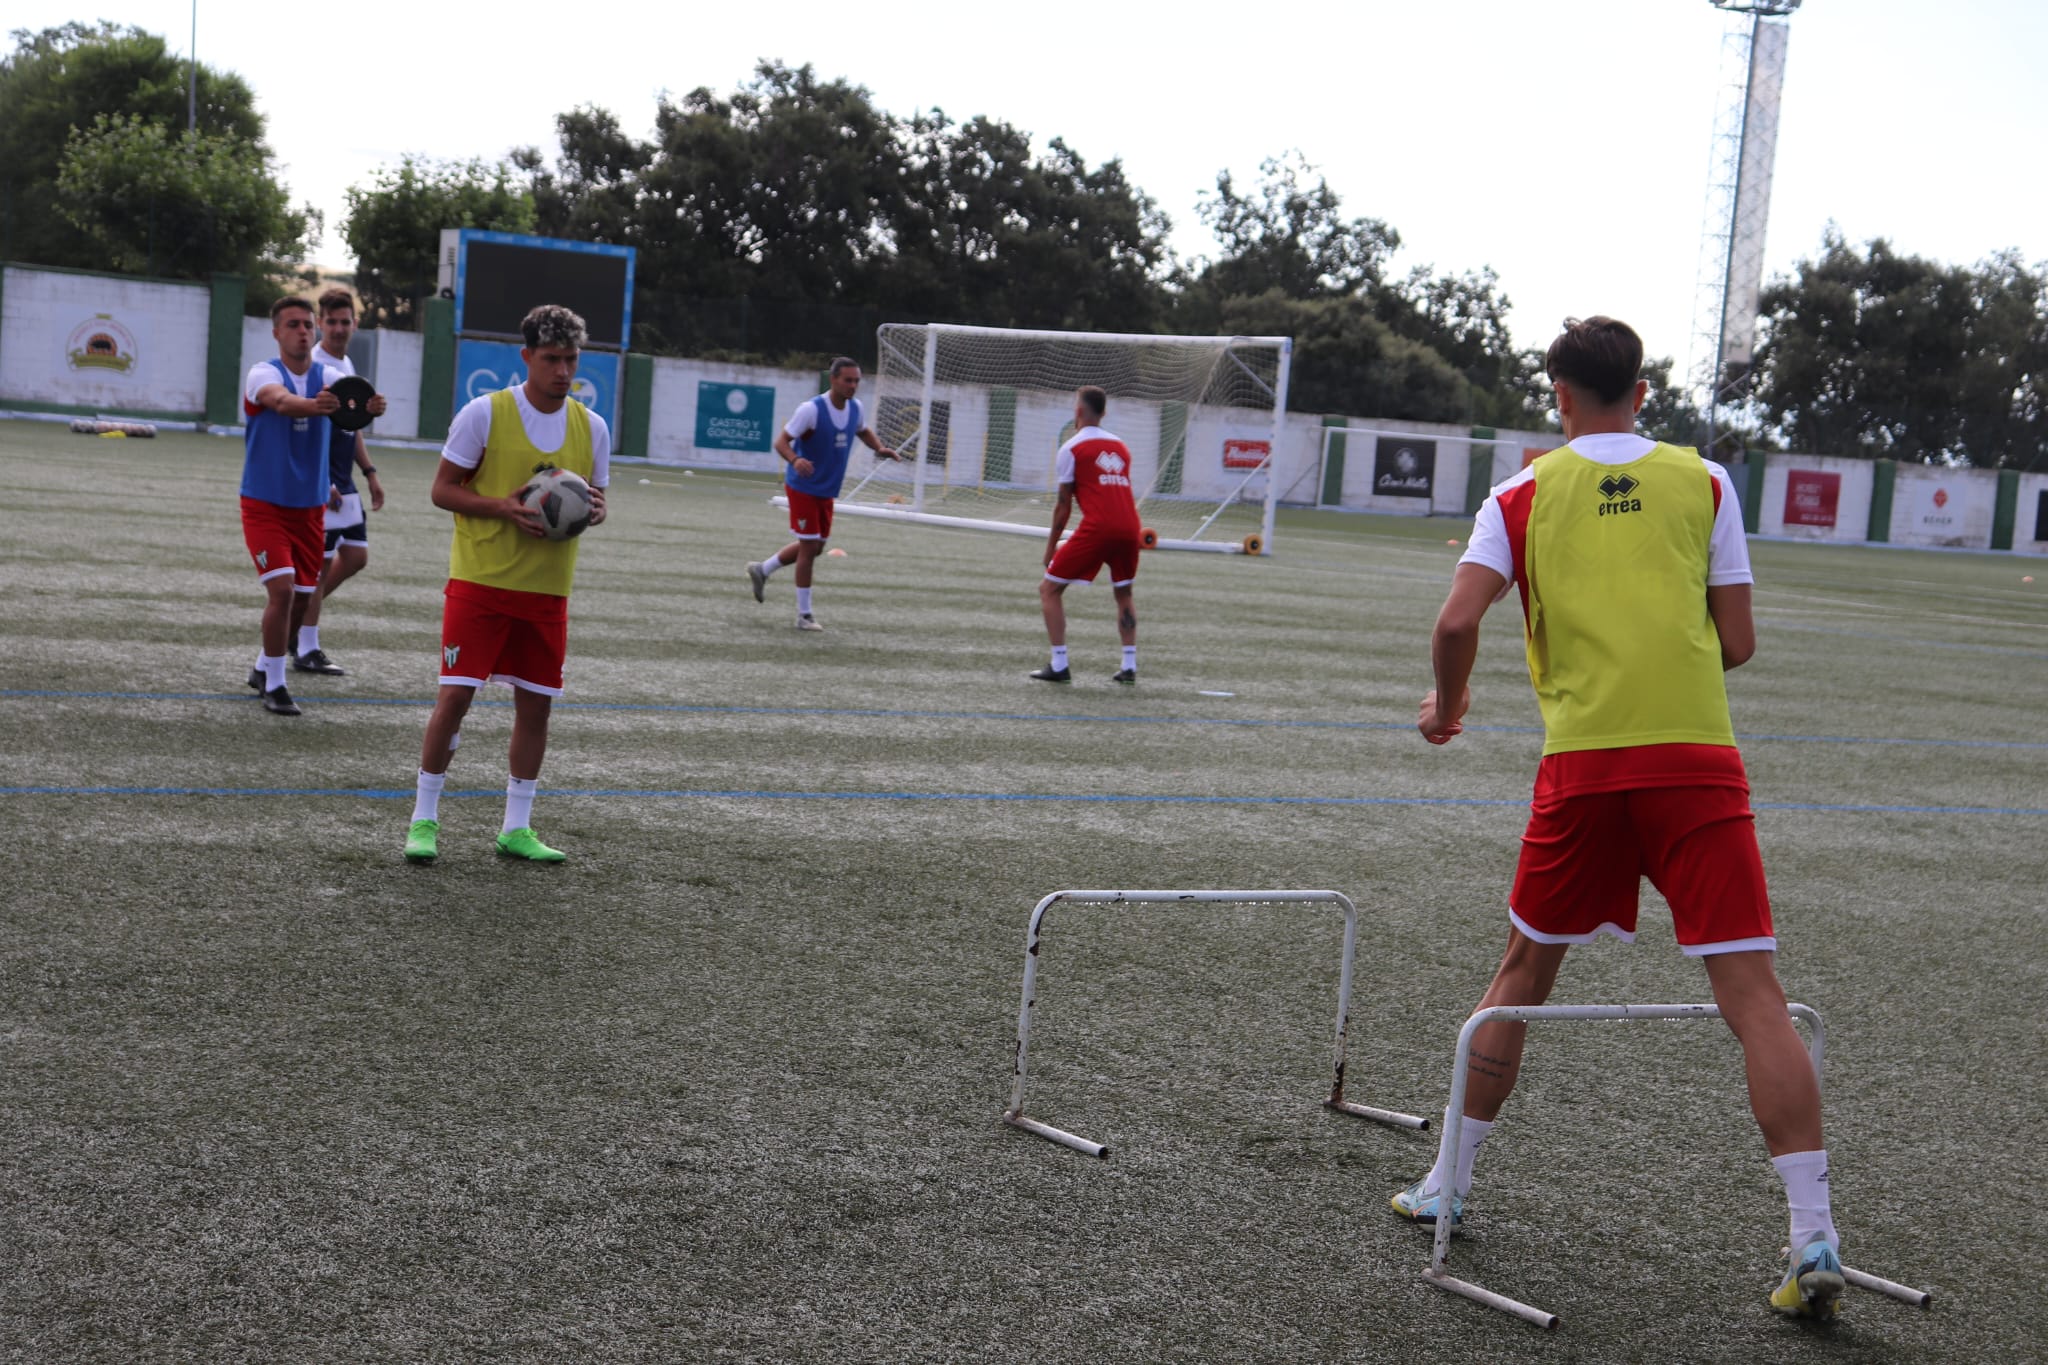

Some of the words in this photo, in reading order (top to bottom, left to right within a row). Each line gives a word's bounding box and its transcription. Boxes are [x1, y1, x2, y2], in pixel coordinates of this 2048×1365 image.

[709, 416, 750, 430] CASTRO
[752, 420, 760, 430] Y
[1598, 499, 1642, 517] errea
